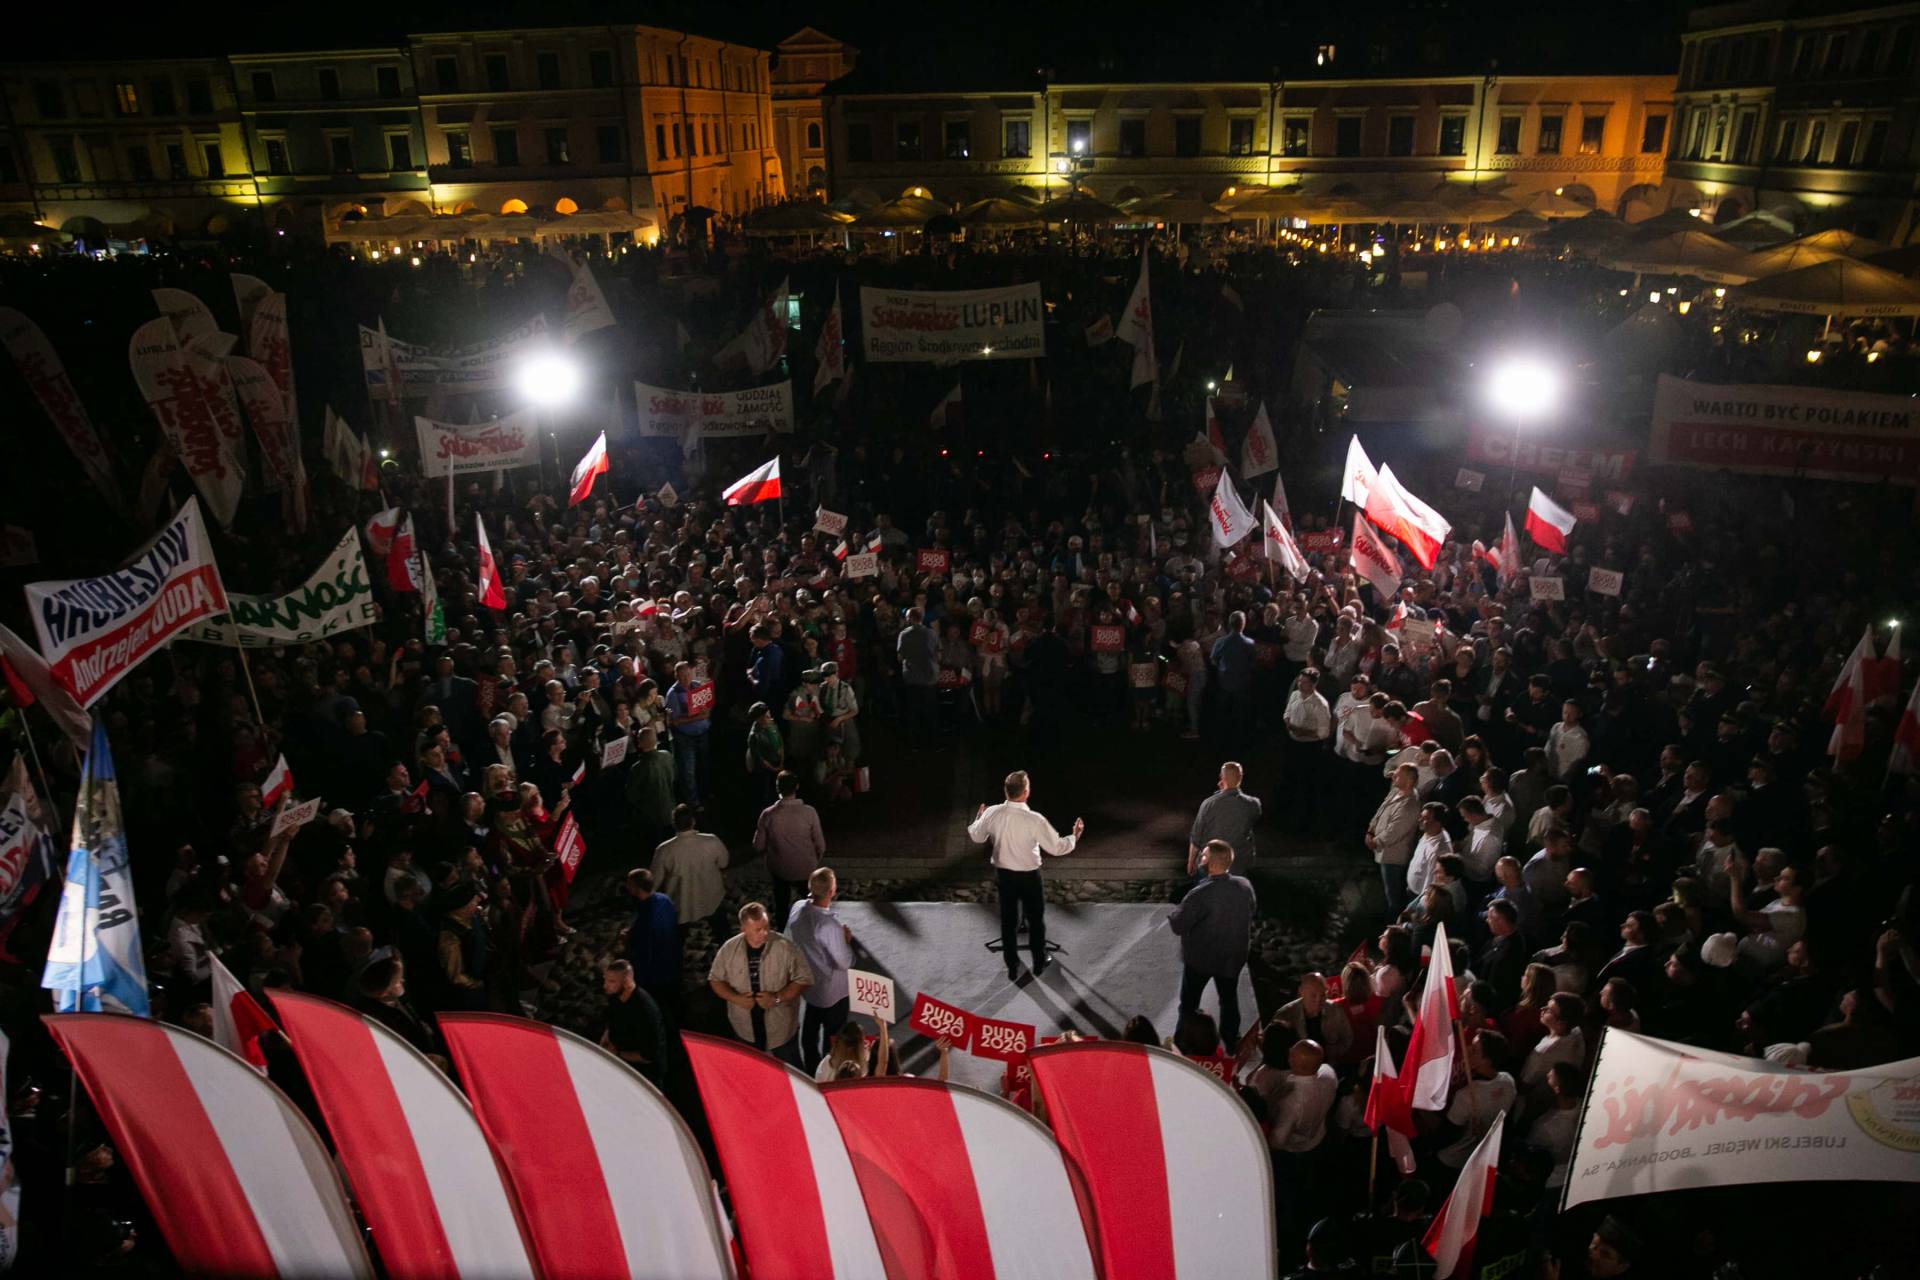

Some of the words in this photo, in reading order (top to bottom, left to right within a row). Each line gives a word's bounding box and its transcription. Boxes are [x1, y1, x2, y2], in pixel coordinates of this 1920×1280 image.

[963, 299, 1040, 329] LUBLIN
[1692, 400, 1757, 417] WARTO
[1764, 401, 1800, 420] BYĆ
[856, 977, 889, 996] DUDA
[857, 990, 890, 1009] 2020
[923, 1002, 964, 1028] DUDA
[919, 1014, 964, 1038] 2020
[982, 1024, 1027, 1044] DUDA
[980, 1036, 1028, 1054] 2020
